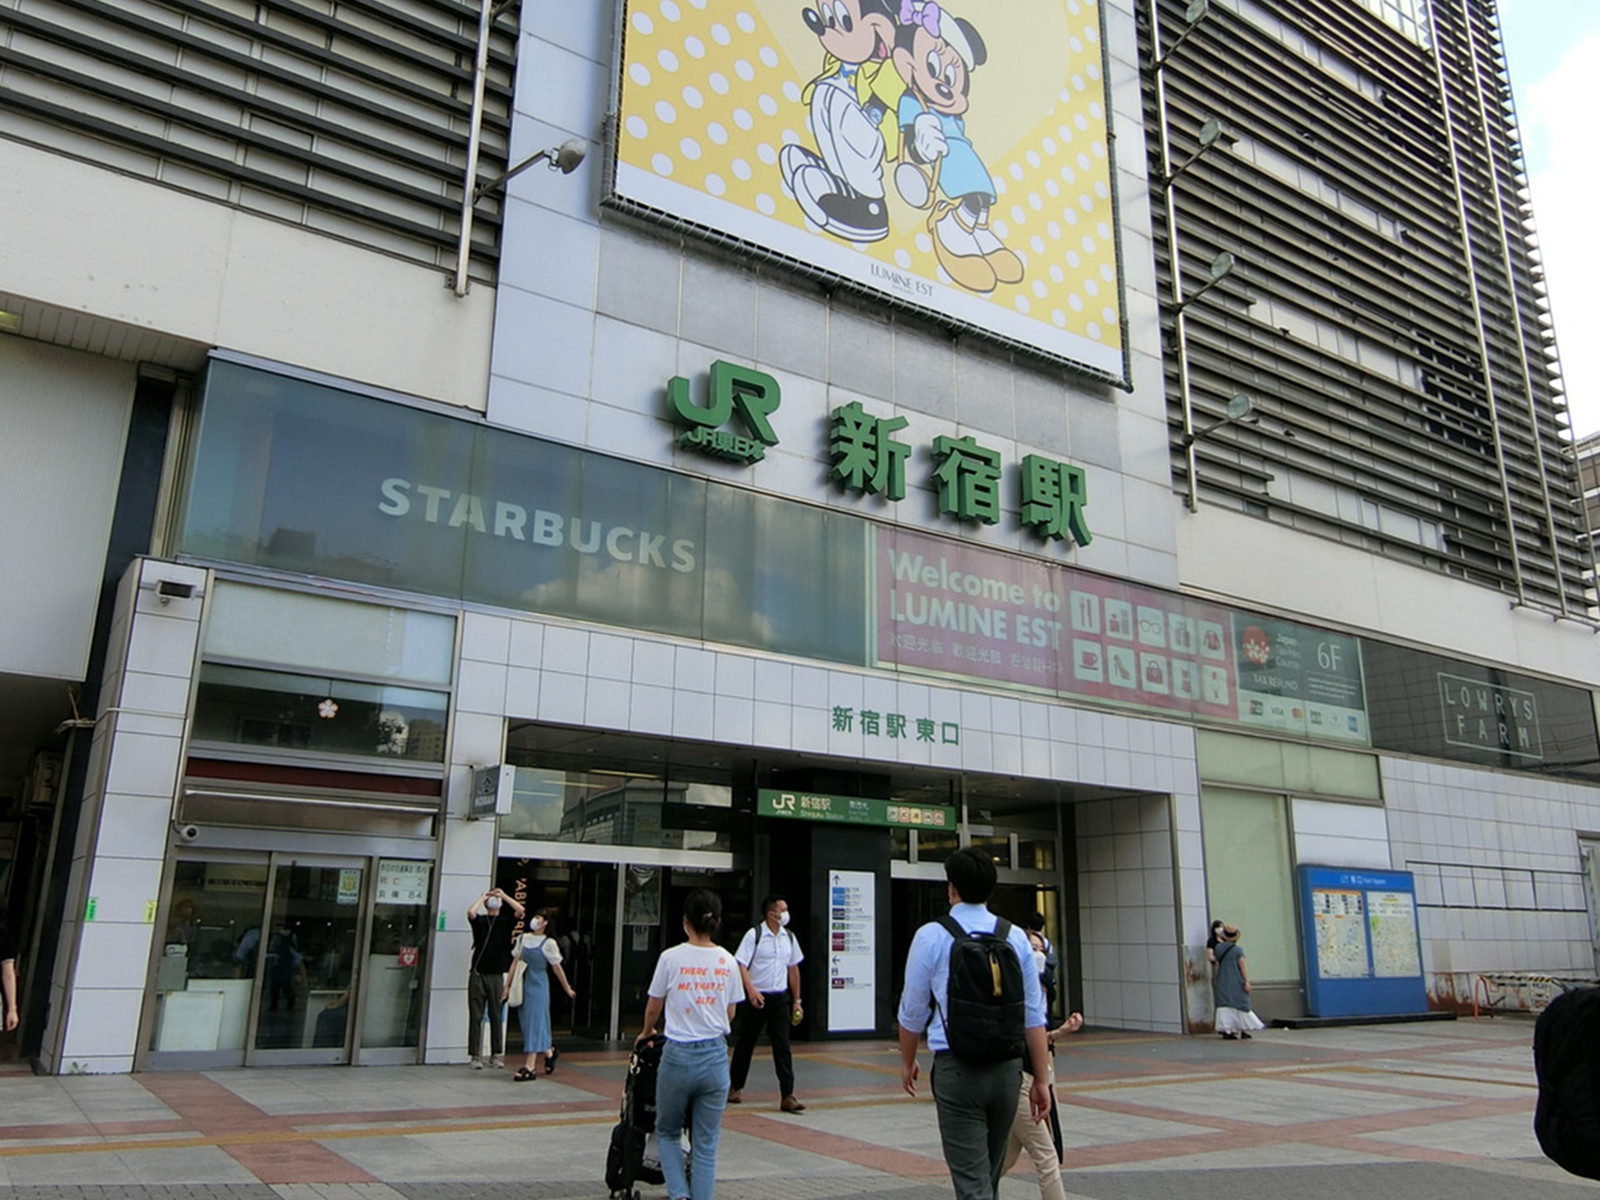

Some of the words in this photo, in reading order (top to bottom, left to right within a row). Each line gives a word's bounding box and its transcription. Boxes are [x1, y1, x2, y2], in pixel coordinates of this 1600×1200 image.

[870, 263, 911, 289] LUMINE
[915, 281, 934, 297] EST
[667, 359, 781, 447] JR
[831, 400, 1093, 548] 新宿駅
[378, 477, 697, 573] STARBUCKS
[887, 550, 1026, 605] Welcome
[1032, 583, 1061, 613] to
[889, 588, 1008, 641] LUMINE
[1015, 612, 1062, 650] EST
[1317, 642, 1342, 671] 6F
[1444, 683, 1533, 720] LOWRYS
[1456, 715, 1530, 748] FARM
[772, 794, 796, 811] JR
[800, 796, 832, 811] 新宿駅
[680, 967, 707, 976] THERE
